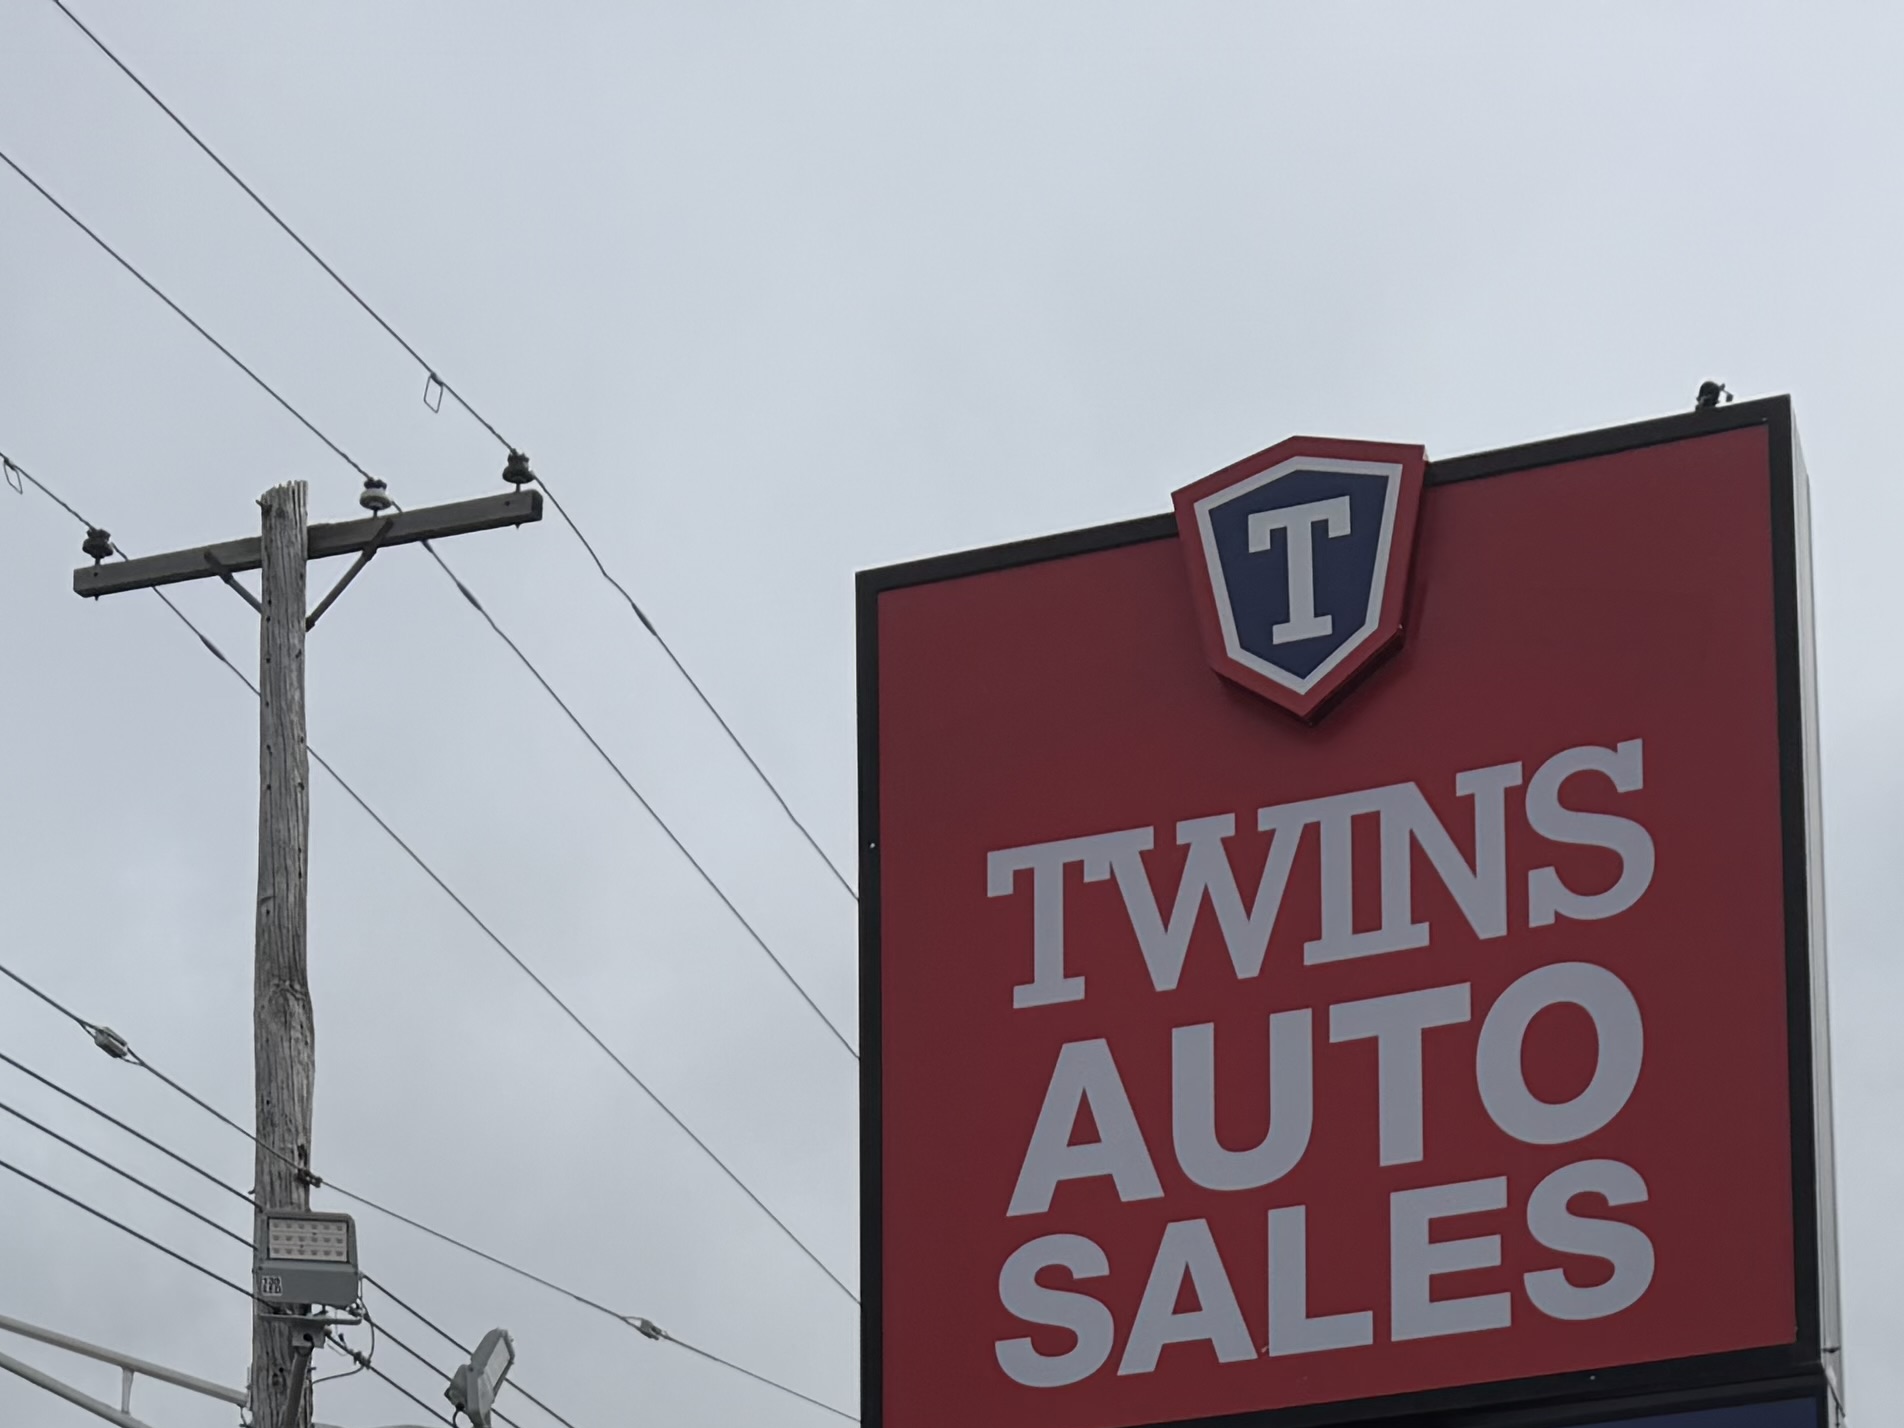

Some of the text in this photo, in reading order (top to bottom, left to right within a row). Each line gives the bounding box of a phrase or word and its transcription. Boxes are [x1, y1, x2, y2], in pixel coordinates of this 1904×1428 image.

[1248, 495, 1351, 645] T
[986, 738, 1655, 1009] TWINS
[1005, 961, 1644, 1217] AUTO
[993, 1158, 1655, 1389] SALES
